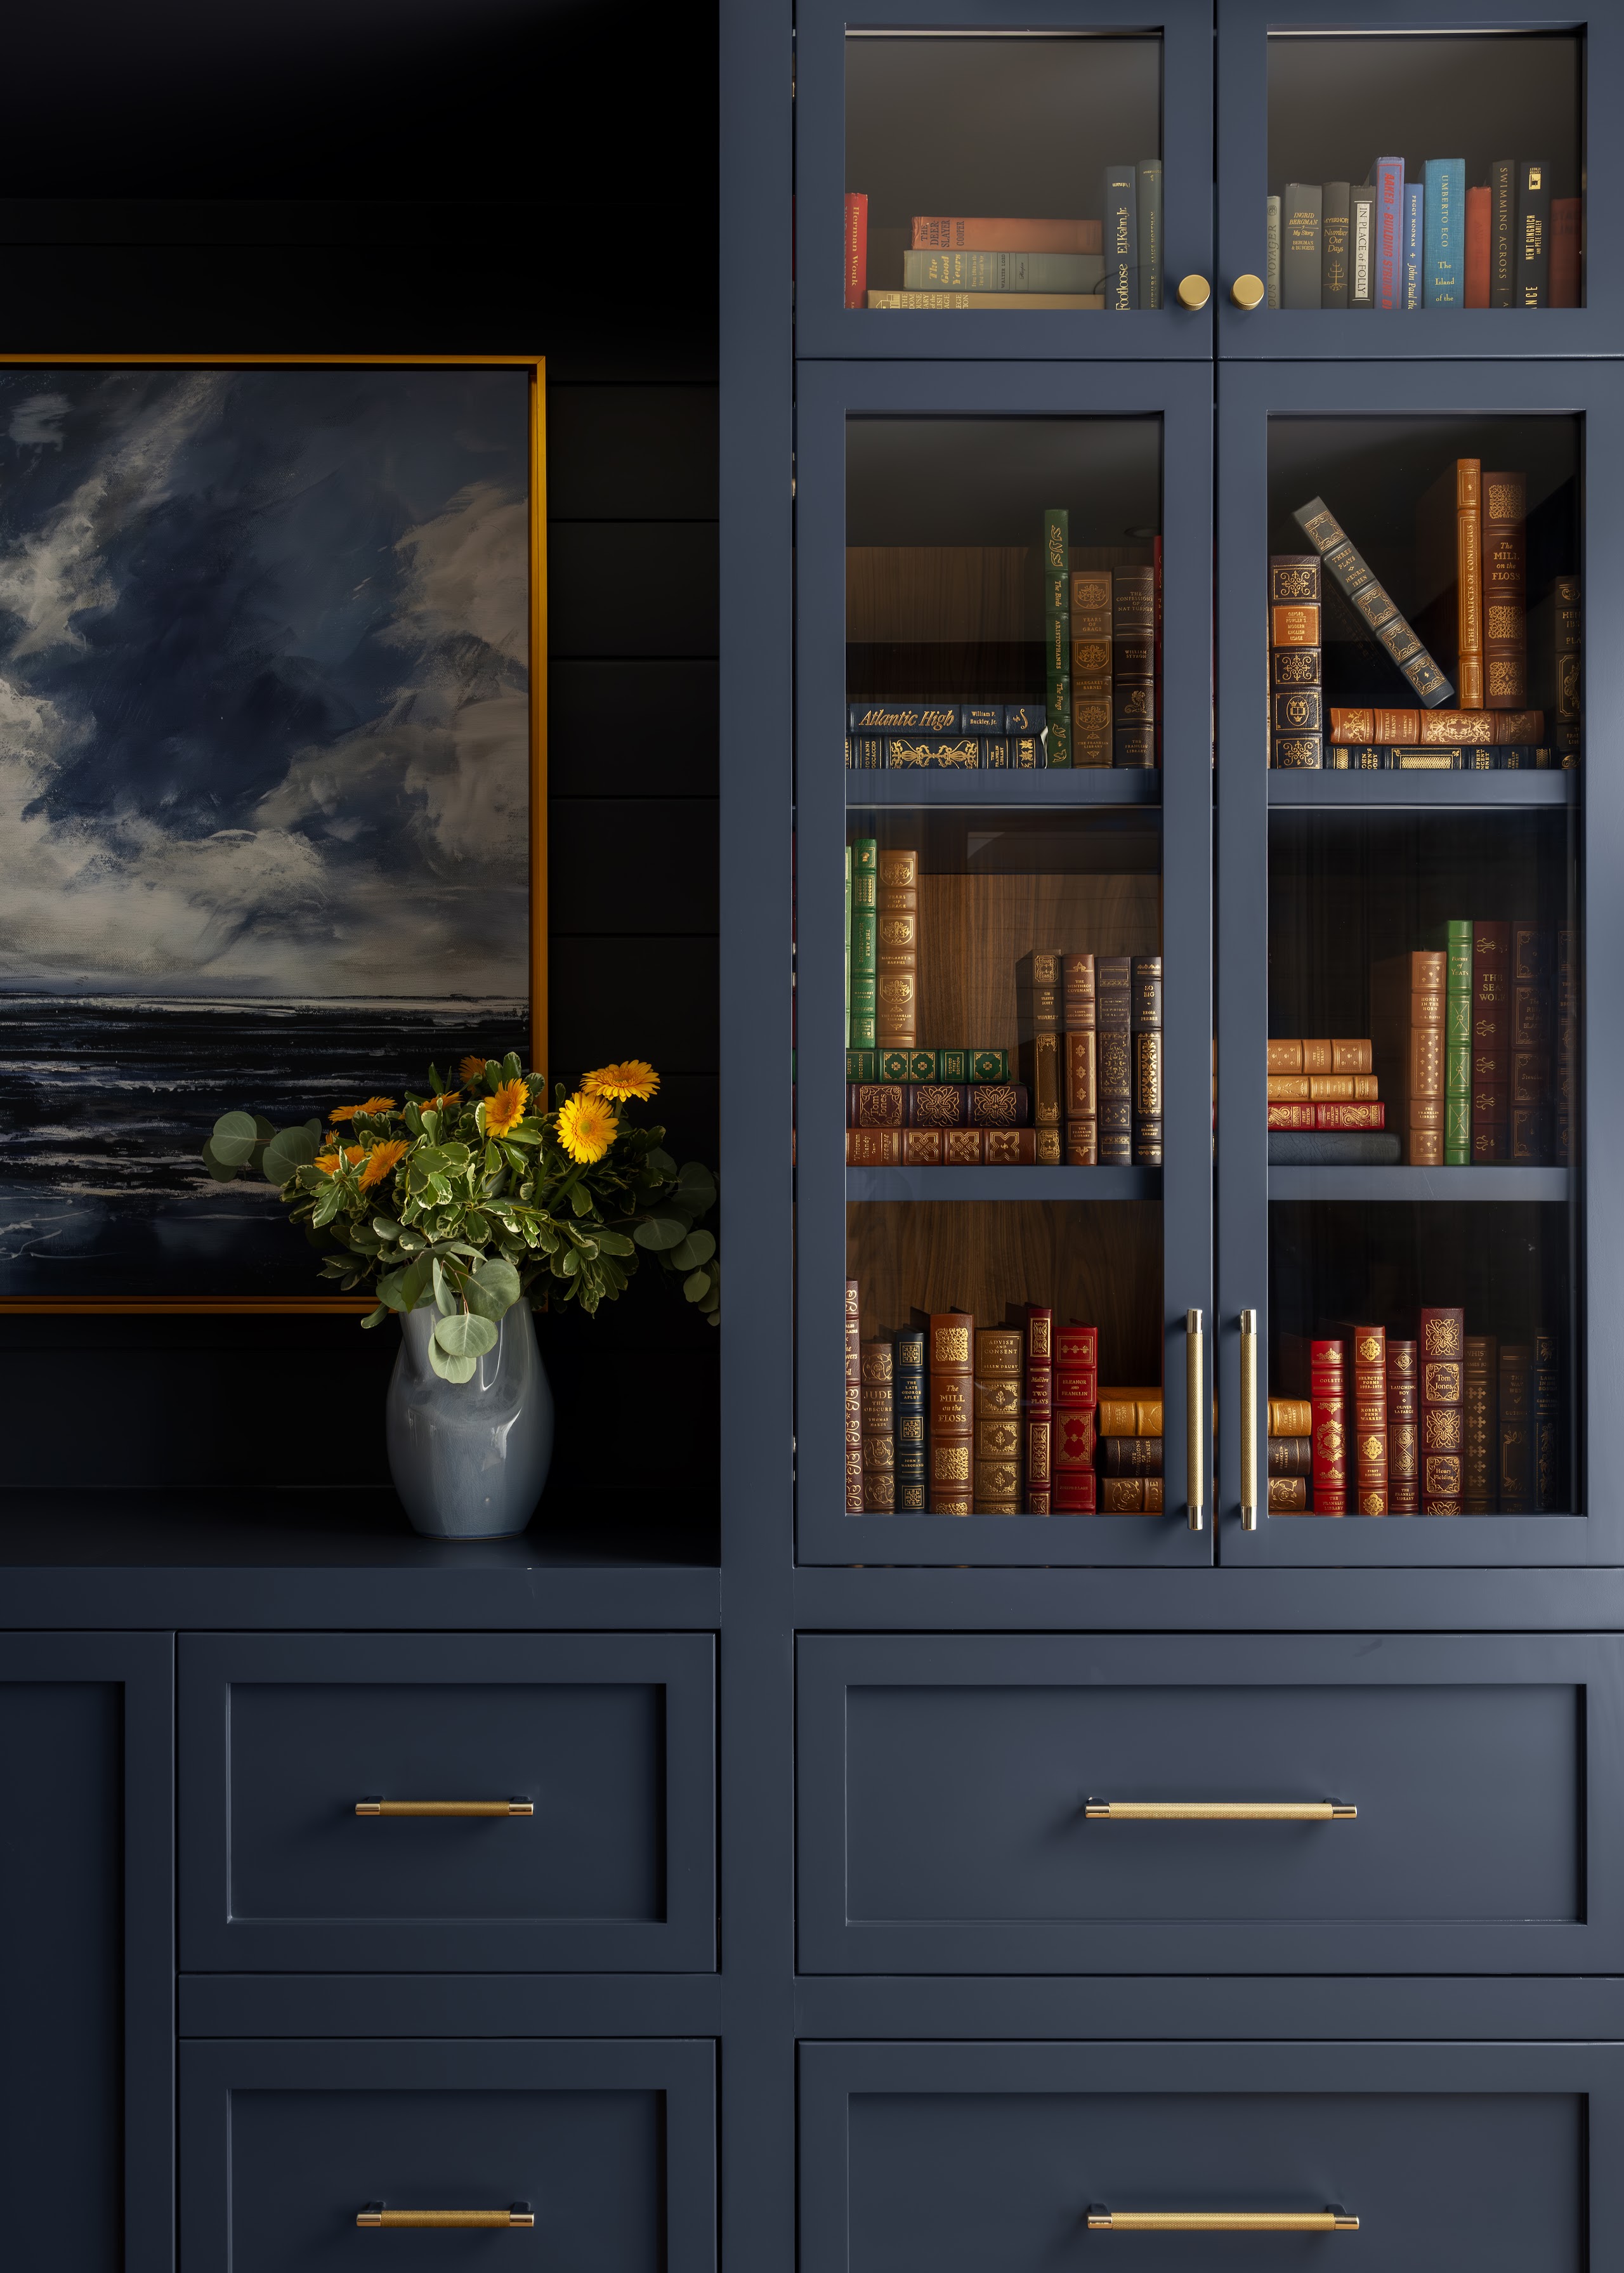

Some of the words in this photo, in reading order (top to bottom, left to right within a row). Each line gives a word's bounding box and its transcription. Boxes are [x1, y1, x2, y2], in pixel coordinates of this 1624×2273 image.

[1384, 173, 1395, 205] AAKER
[1441, 174, 1449, 224] UMBERTO
[1499, 167, 1508, 231] SWIMMING
[1359, 207, 1368, 218] IN
[941, 219, 950, 248] SLAYER
[956, 221, 964, 246] COOPER
[1324, 228, 1349, 237] Number
[1358, 221, 1367, 251] PLACE
[1382, 213, 1394, 259] BUILDING
[1441, 227, 1449, 247] ECO
[1526, 215, 1535, 243] GINGRICH
[1268, 225, 1280, 278] VOYAGER
[1328, 245, 1344, 253] Days
[1358, 253, 1366, 261] of
[1499, 236, 1507, 279] ACROSS
[1525, 244, 1535, 261] NEWT
[929, 258, 938, 279] The
[941, 255, 950, 284] Good
[953, 254, 961, 285] Years
[1407, 263, 1418, 280] John
[1437, 261, 1452, 269] The
[1116, 263, 1130, 310] Footloose
[1357, 265, 1366, 294] FOLLY
[1381, 259, 1393, 297] STRONG
[1435, 277, 1455, 285] Island
[1408, 282, 1418, 299] Paul
[1436, 294, 1443, 302] of
[1332, 547, 1352, 563] THREE
[1338, 555, 1356, 570] PLAYS
[1346, 567, 1366, 583] HENRIK
[1352, 575, 1368, 587] IBSEN
[1467, 574, 1474, 584] OF
[1491, 572, 1521, 580] FLOSS
[1055, 695, 1063, 711] Frogs
[858, 709, 919, 727] Atlantic
[919, 710, 955, 731] High
[870, 1095, 879, 1115] Tom
[879, 1093, 887, 1118] Jones
[863, 1390, 893, 1399] JUDE
[1435, 1382, 1453, 1391] Jones
[938, 1414, 967, 1422] FLOSS
